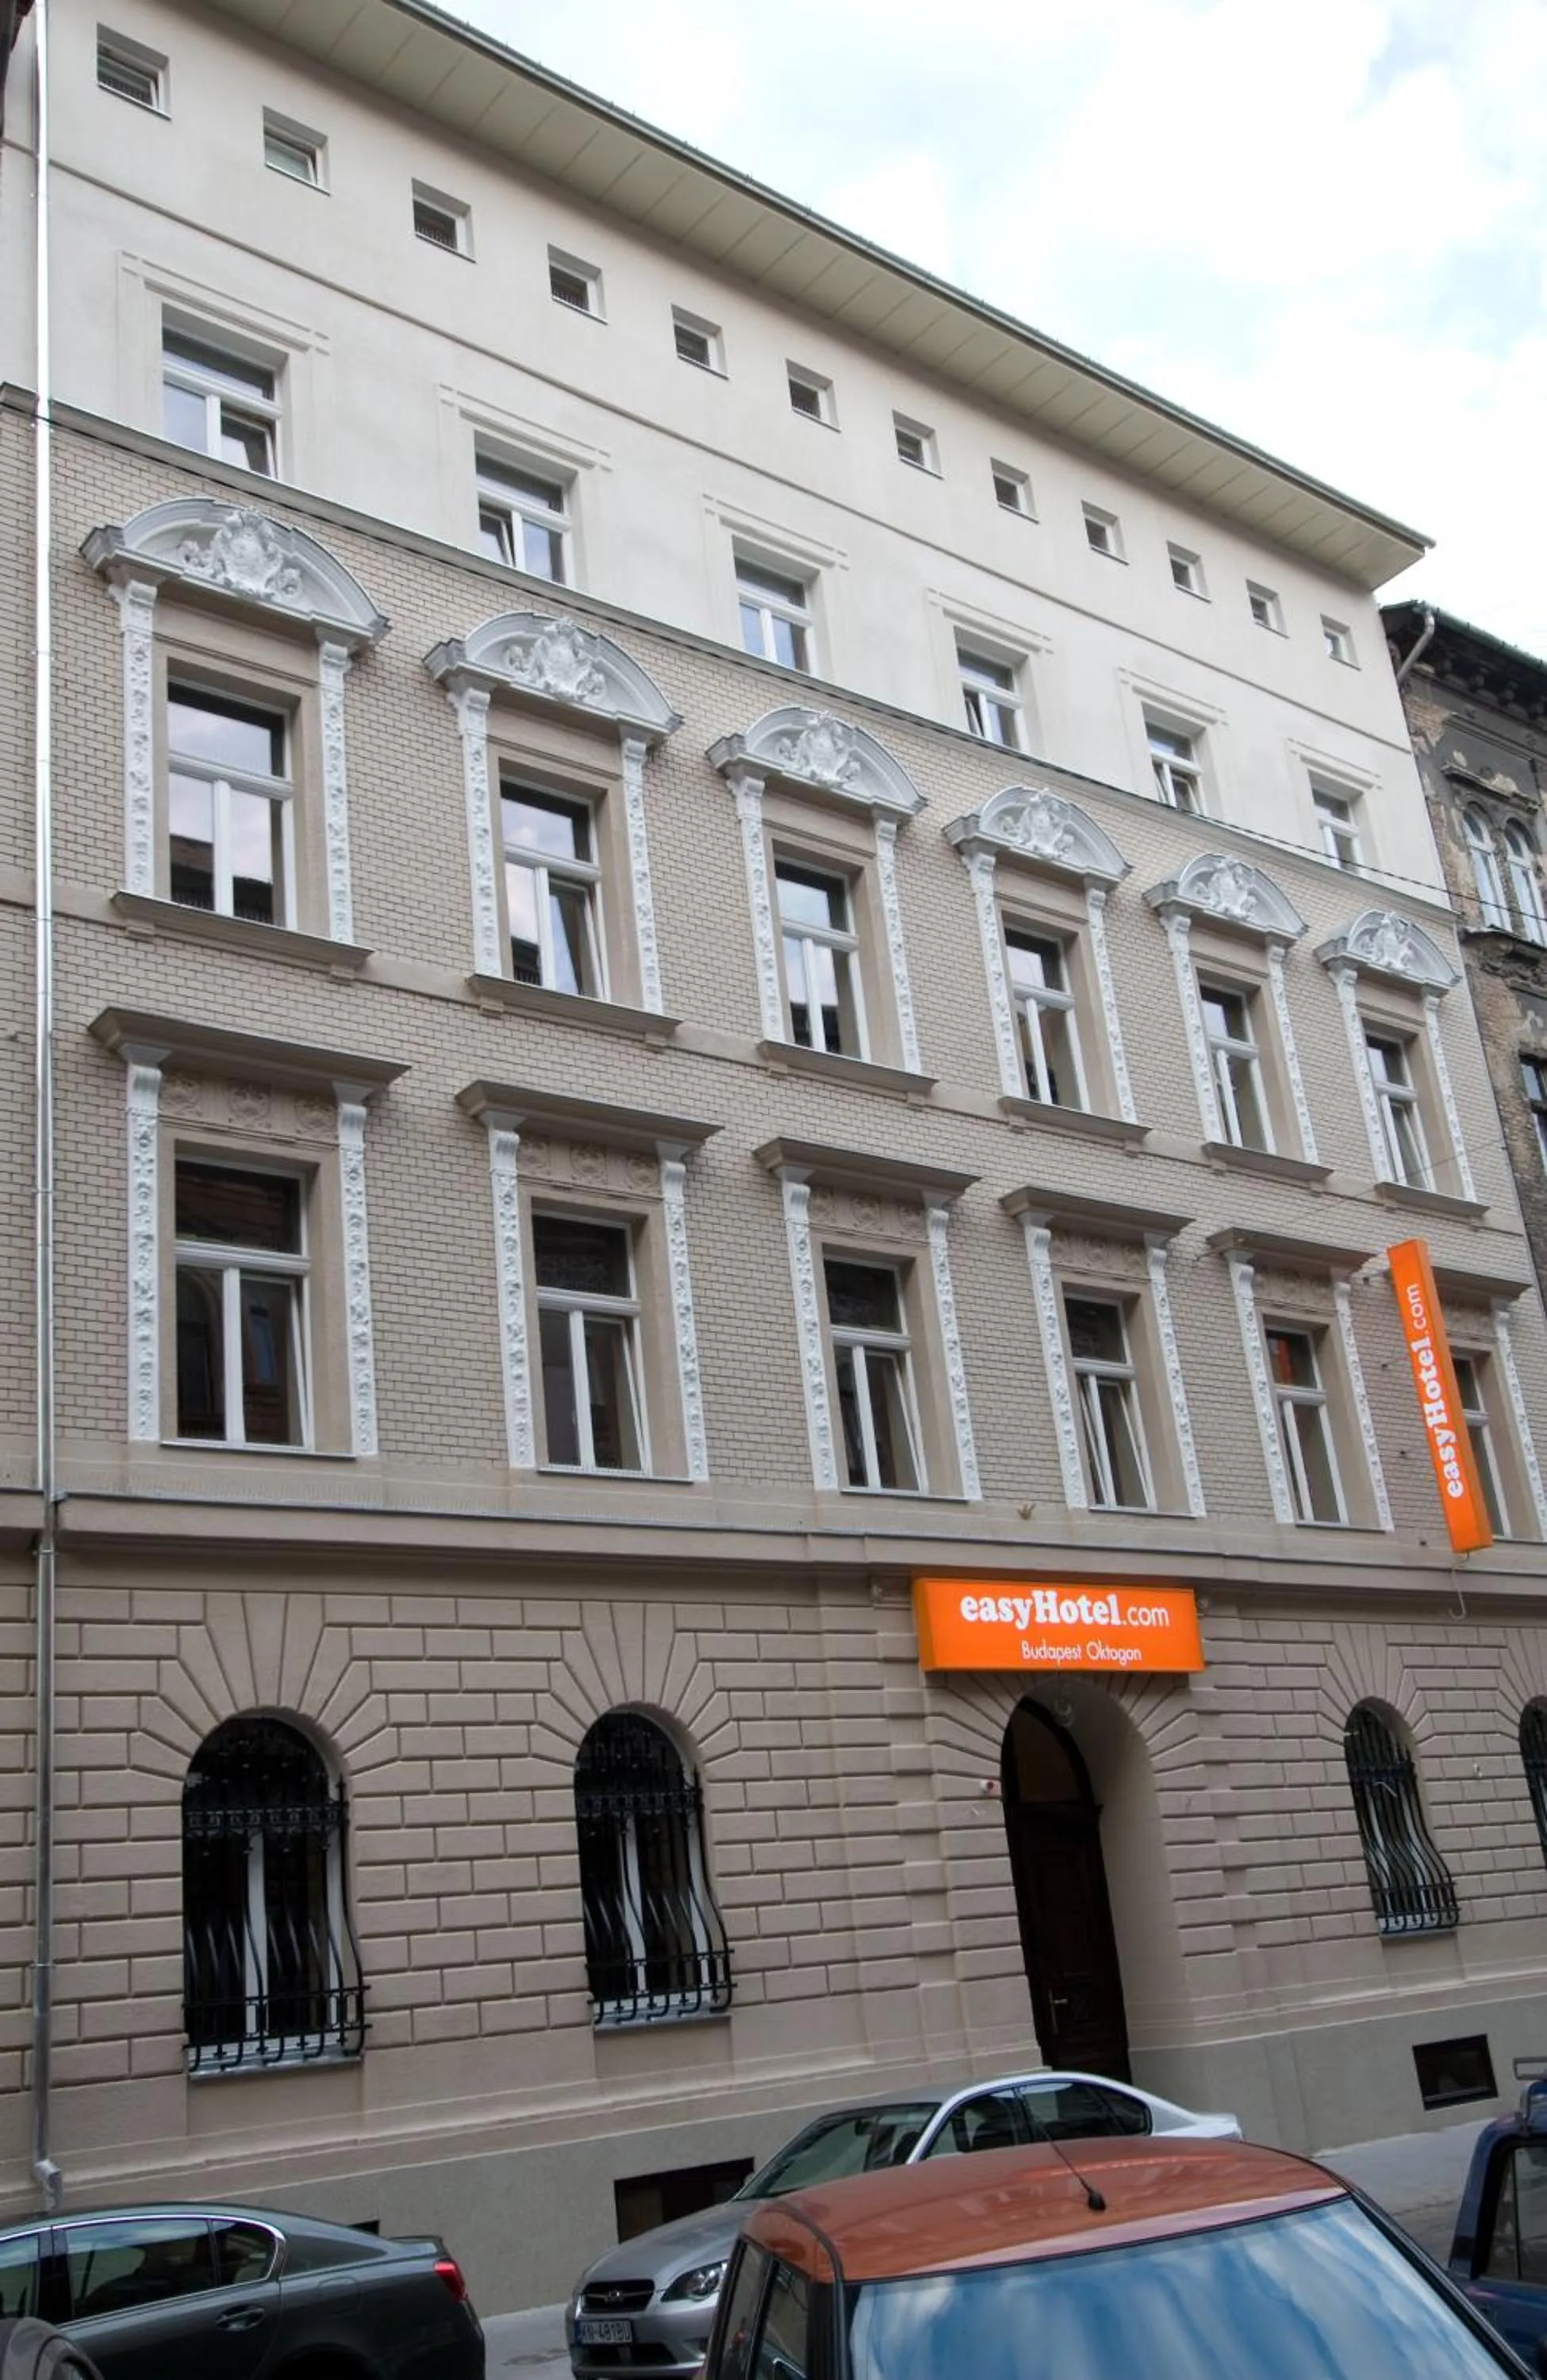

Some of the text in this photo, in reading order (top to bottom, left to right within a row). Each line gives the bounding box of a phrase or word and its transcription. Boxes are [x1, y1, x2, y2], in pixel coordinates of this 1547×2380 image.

[1405, 1283, 1464, 1498] easyHotel.com
[960, 1590, 1170, 1630] easyHotel.com
[1021, 1638, 1142, 1665] Budapest Oktogon
